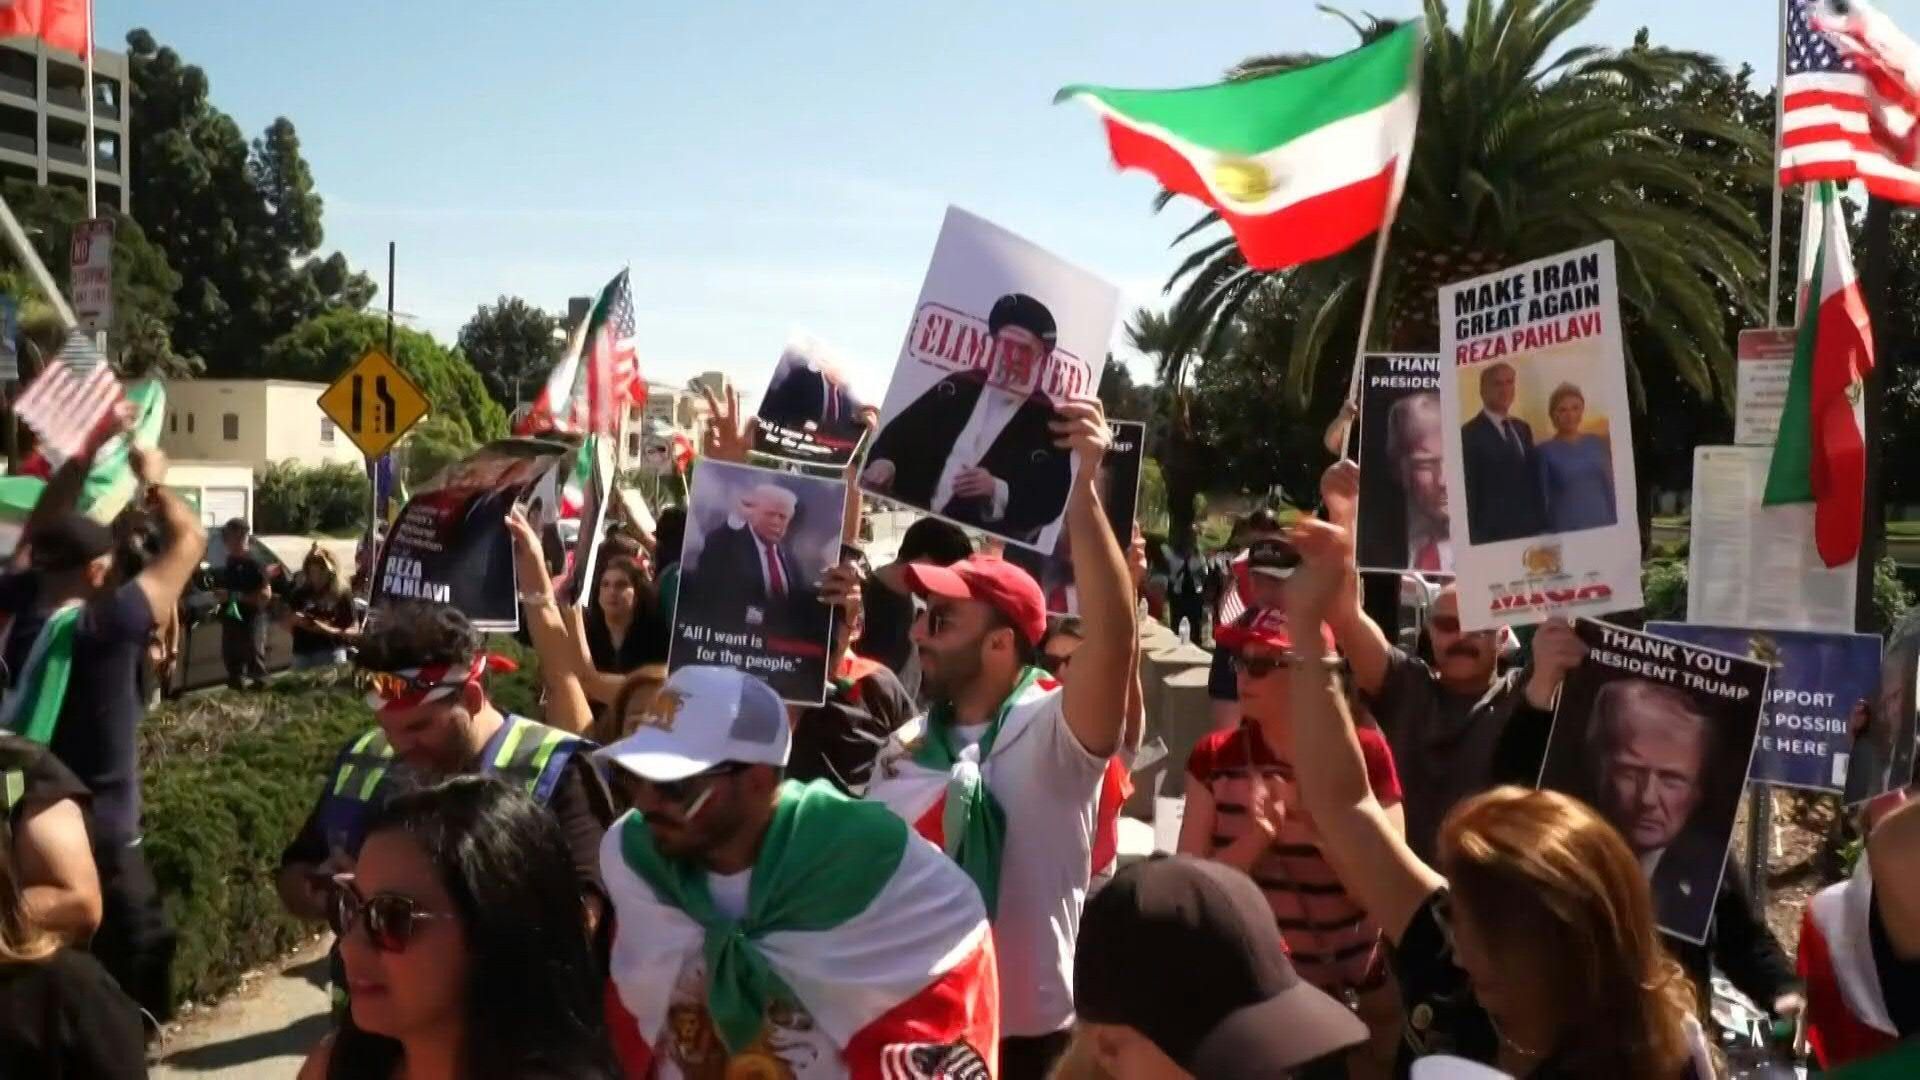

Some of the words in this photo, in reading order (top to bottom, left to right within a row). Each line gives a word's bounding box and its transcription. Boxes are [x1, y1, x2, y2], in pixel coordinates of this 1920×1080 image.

[74, 240, 88, 260] NO
[1455, 273, 1525, 317] MAKE
[1533, 253, 1598, 294] IRAN
[1456, 304, 1522, 341] GREAT
[1528, 284, 1599, 323] AGAIN
[1456, 336, 1507, 365] REZA
[1512, 312, 1601, 352] PAHLAVI
[1371, 376, 1440, 388] PRESIDEN
[386, 556, 422, 578] REZA
[382, 575, 450, 603] PAHLAVI
[706, 628, 711, 642] I
[715, 631, 747, 647] want
[751, 633, 763, 648] is
[697, 646, 717, 661] for
[720, 649, 742, 665] the
[1602, 629, 1677, 661] THANK
[1683, 650, 1731, 676] YOU
[1590, 648, 1677, 682] RESIDENT
[1683, 672, 1750, 699] TRUMP
[1777, 738, 1828, 757] HERE
